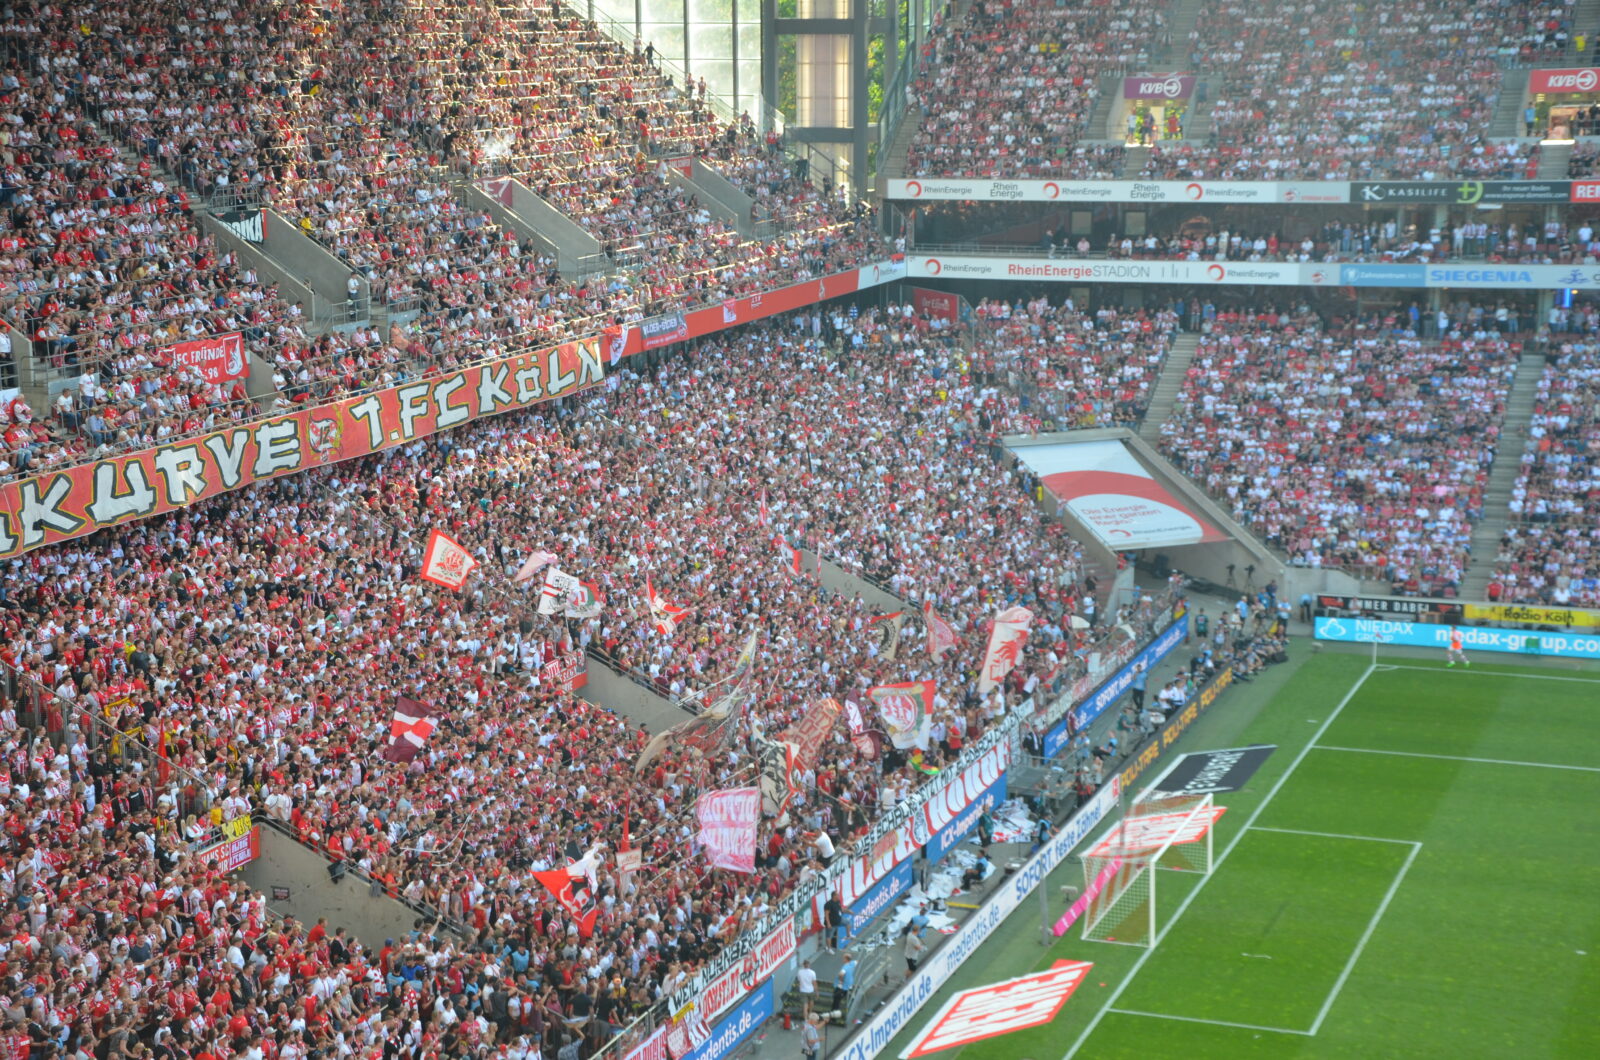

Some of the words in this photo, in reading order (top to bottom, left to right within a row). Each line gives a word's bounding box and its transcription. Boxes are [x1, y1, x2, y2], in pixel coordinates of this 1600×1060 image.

[1547, 75, 1577, 88] KVB
[1139, 82, 1164, 94] KVB
[924, 186, 973, 196] RheinEnergie
[993, 182, 1018, 191] Rhein
[1062, 187, 1112, 197] RheinEnergie
[1134, 183, 1160, 192] Rhein
[1387, 187, 1448, 197] KASILIFE
[990, 189, 1024, 199] Energie
[1130, 190, 1166, 200] Energie
[1205, 188, 1258, 198] RheinEnergie
[943, 263, 992, 274] RheinEnergie
[1227, 269, 1280, 279] RheinEnergie
[1430, 269, 1532, 283] SIEGENIA
[176, 352, 189, 365] FC
[190, 345, 225, 364] FRÜNDE
[0, 417, 302, 551] KURVE
[477, 340, 605, 416] KÖLN
[1503, 607, 1541, 621] Radio
[1545, 611, 1575, 623] Köln
[1355, 619, 1414, 635] NIEDAX
[853, 876, 900, 932] medentis.de
[842, 974, 932, 1060] CX-Imperial.de
[946, 904, 1000, 973] medentis.de
[1055, 831, 1075, 862] feste
[673, 980, 699, 1010] WEIL
[693, 1009, 752, 1060] edentis.de
